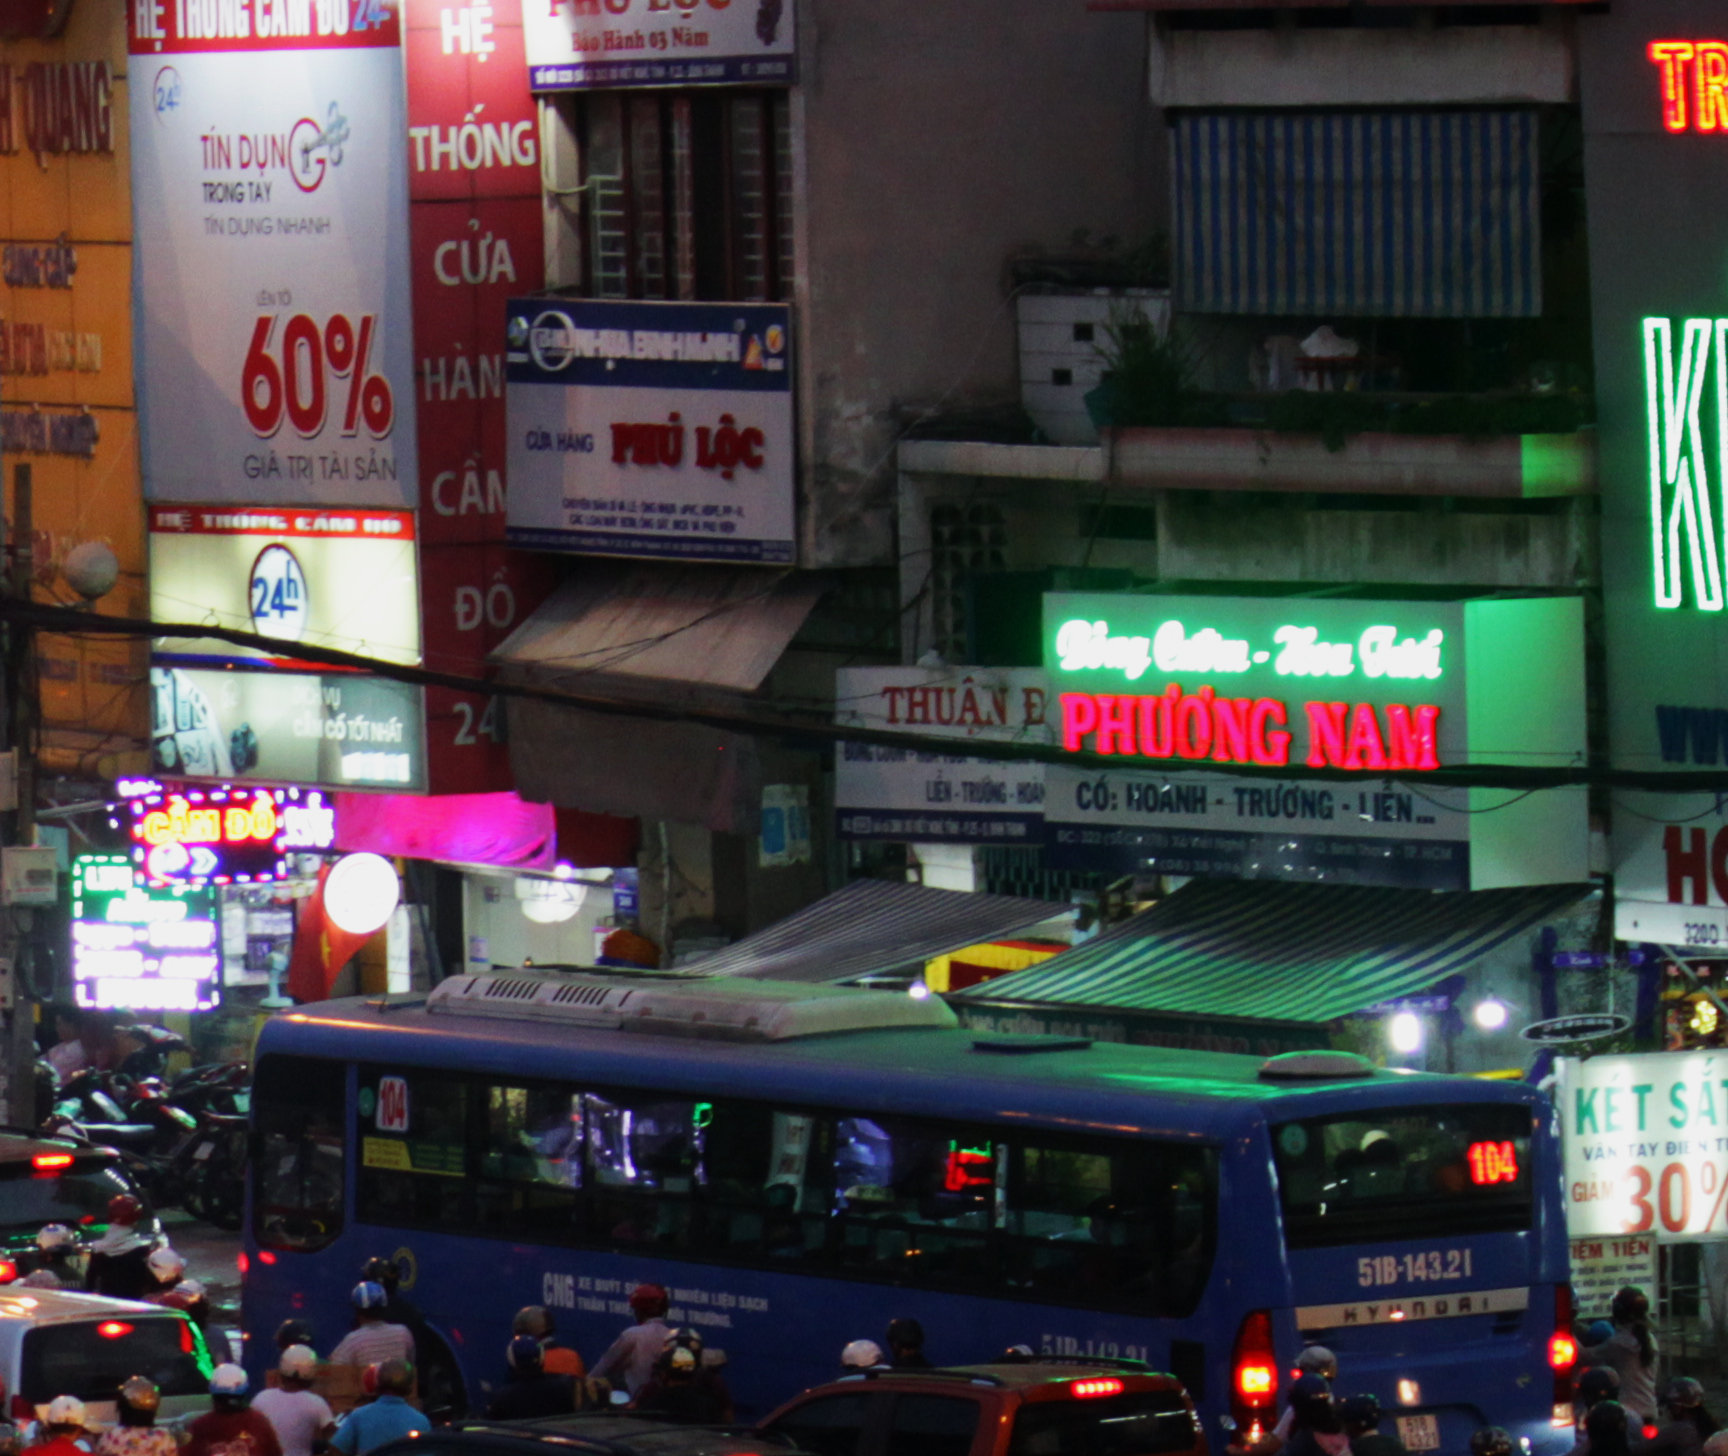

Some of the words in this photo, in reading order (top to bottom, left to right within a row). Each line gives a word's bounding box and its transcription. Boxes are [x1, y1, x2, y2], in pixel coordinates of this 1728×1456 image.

[200, 126, 231, 170] TÍN
[409, 104, 536, 172] THỐNG
[202, 182, 244, 203] TRONG
[246, 181, 273, 202] TAY
[277, 217, 330, 235] NHANH
[434, 219, 517, 286] CỬA
[242, 313, 394, 439] 60%
[423, 342, 506, 401] HÀN
[244, 450, 280, 479] GIÁ
[289, 455, 314, 486] TRỊ
[318, 451, 349, 480] TÀI
[354, 448, 397, 481] SẢN
[695, 413, 765, 480] LỘC
[1643, 317, 1728, 611] K
[252, 559, 299, 619] 24h
[453, 567, 516, 630] ĐỒ
[882, 676, 1010, 736] THUẬN
[1303, 701, 1441, 771] NAM
[378, 1077, 408, 1129] 104
[1575, 1072, 1654, 1136] KẾT
[1467, 1139, 1519, 1185] 104
[543, 1272, 575, 1310] CNG
[1357, 1247, 1473, 1287] 51B-143.21
[1343, 1295, 1489, 1322] HYUNDAI
